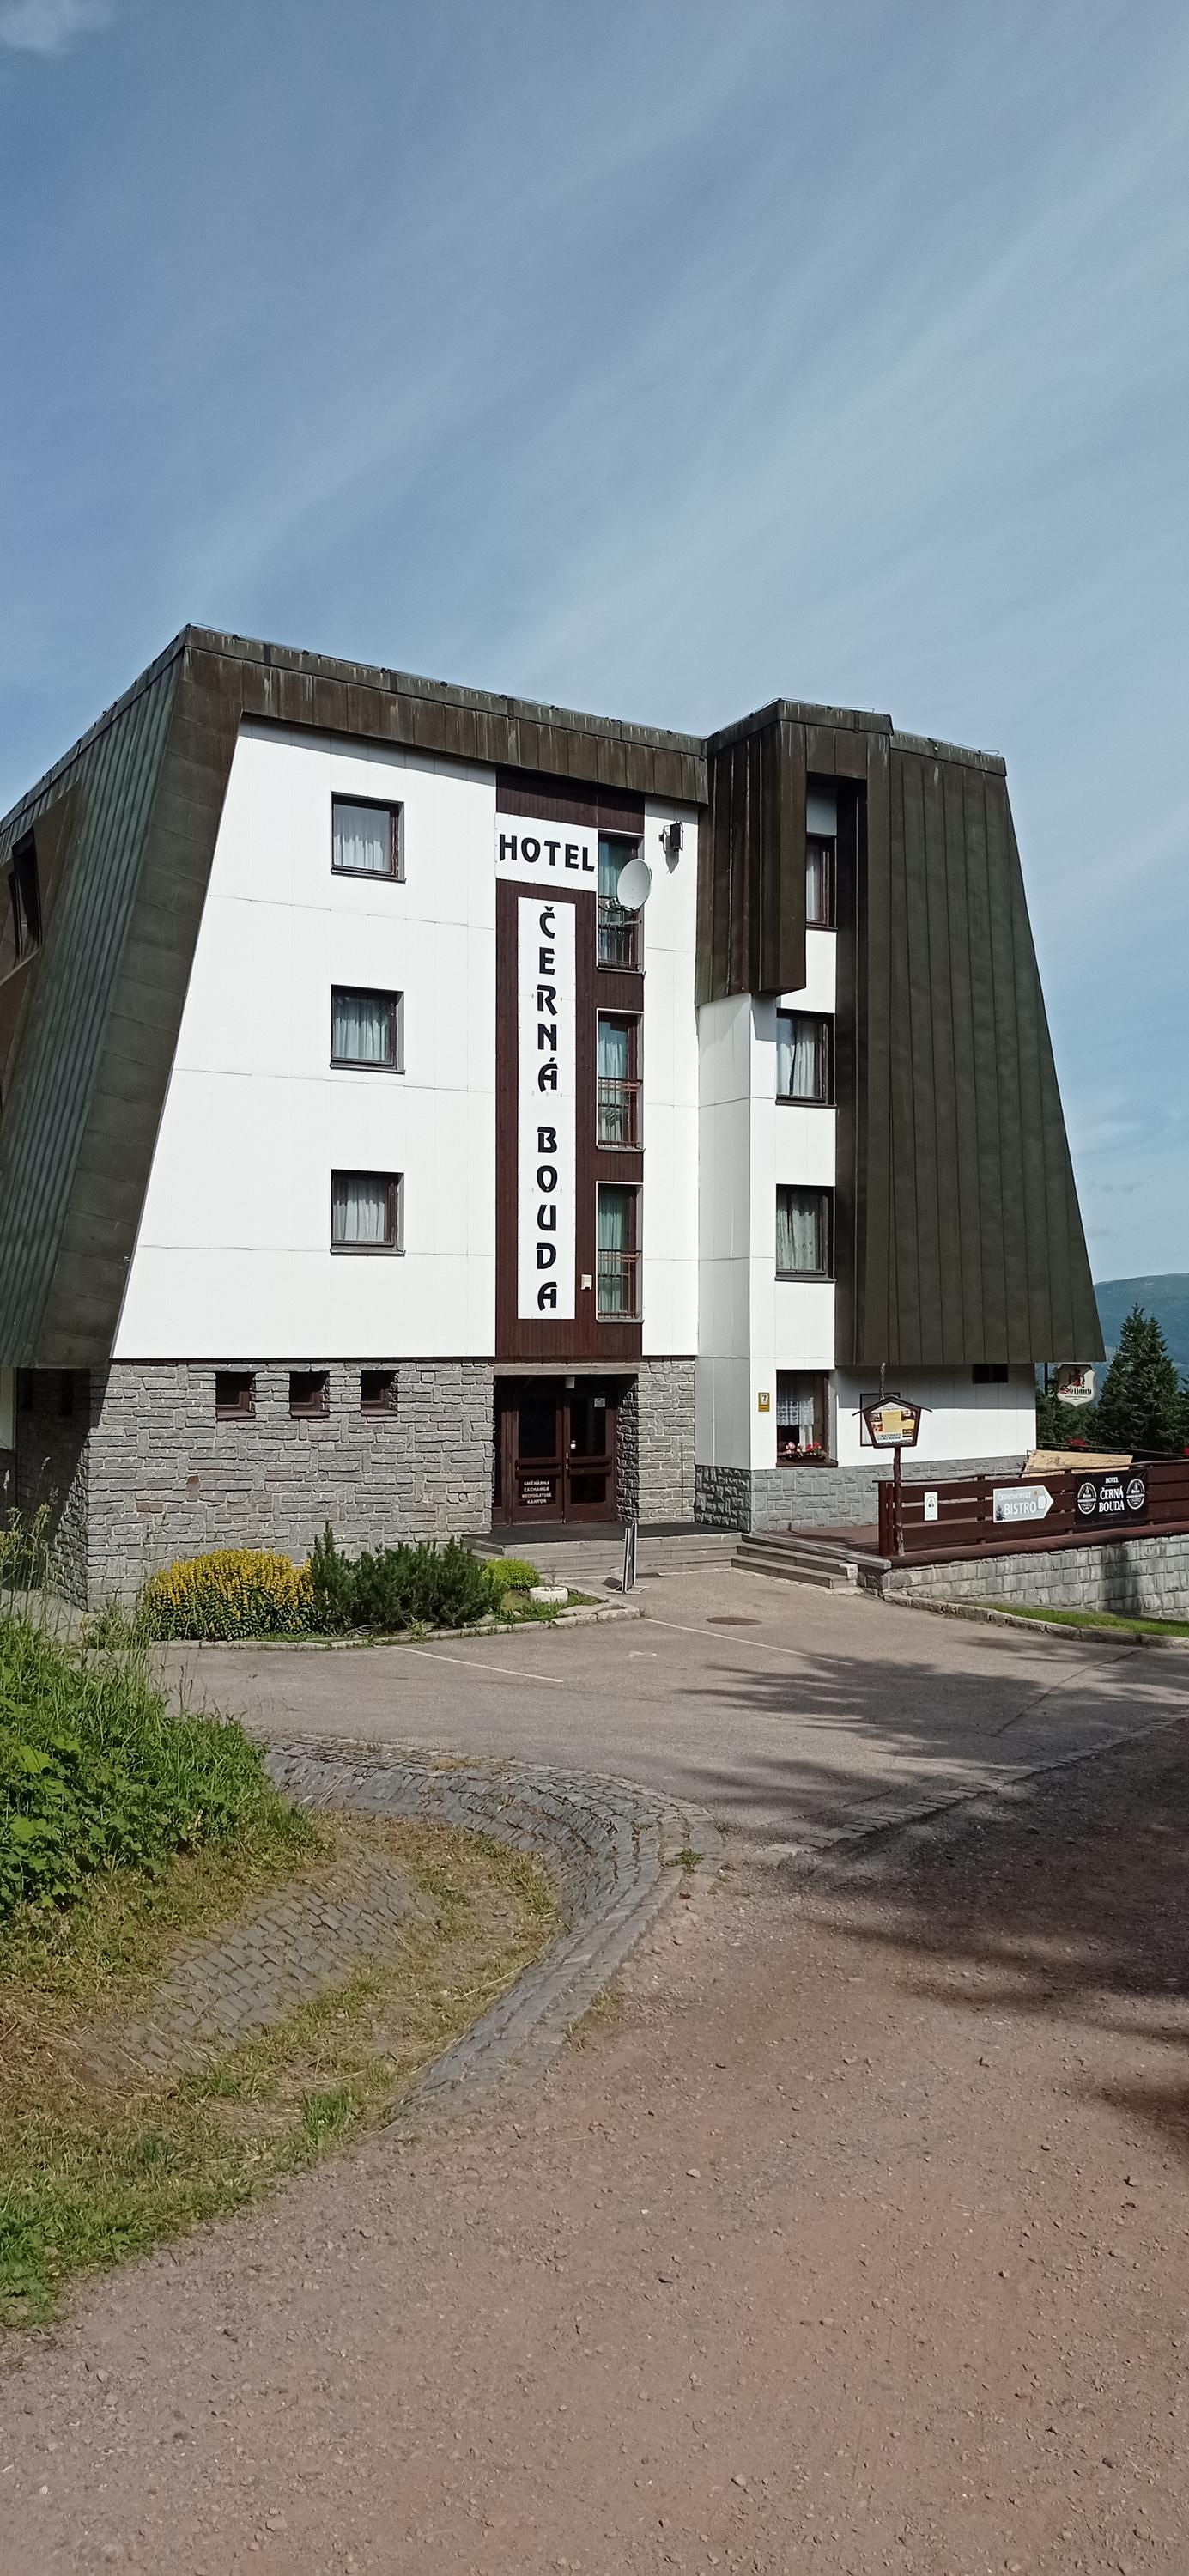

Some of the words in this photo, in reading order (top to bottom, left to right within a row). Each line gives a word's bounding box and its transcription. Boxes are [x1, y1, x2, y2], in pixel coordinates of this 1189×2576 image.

[499, 833, 595, 872] HOTEL
[537, 906, 558, 1092] ČERNÁ
[536, 1126, 558, 1311] BOUDA
[1100, 1485, 1124, 1500] ČERNÁ
[1004, 1501, 1037, 1516] BISTRO
[1098, 1500, 1125, 1513] BOUDA
